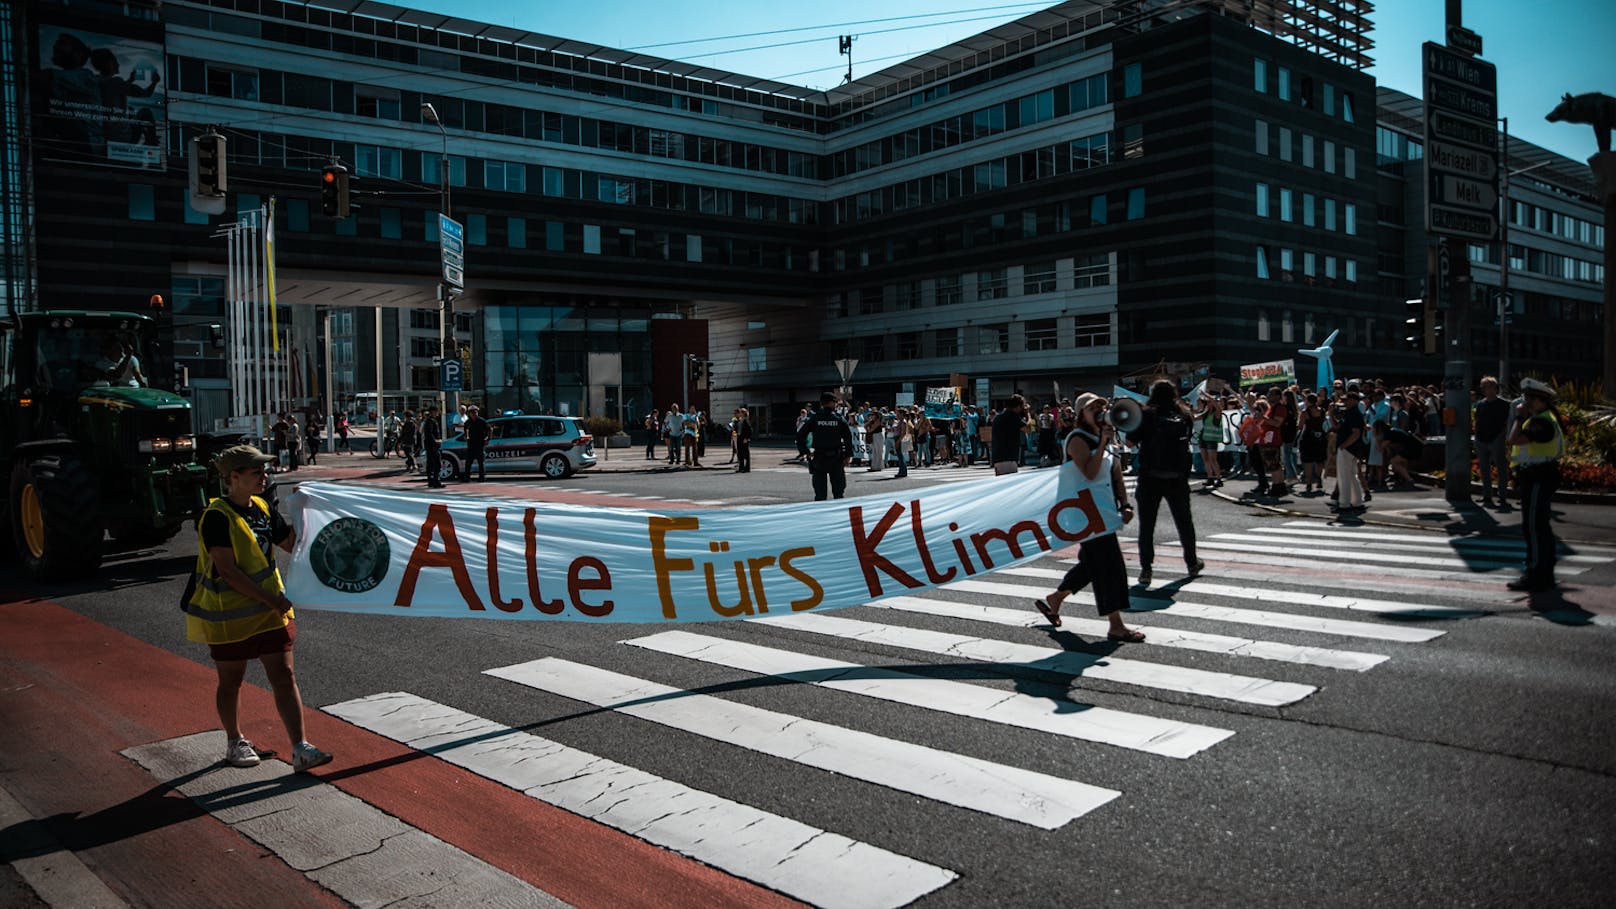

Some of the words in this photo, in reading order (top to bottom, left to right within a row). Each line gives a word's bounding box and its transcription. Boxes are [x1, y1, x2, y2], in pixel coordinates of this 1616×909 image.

[1456, 59, 1480, 85] Wien
[1461, 90, 1490, 115] Krems
[1432, 143, 1477, 173] Mariazell
[1456, 181, 1481, 204] Melk
[446, 365, 459, 382] P
[817, 420, 838, 428] POLIZEI
[318, 519, 365, 545] FRIDAYS
[365, 524, 387, 546] FOR
[394, 503, 614, 617] Alle
[648, 516, 824, 619] Fürs
[849, 488, 1106, 598] Klima
[328, 576, 377, 592] FUTURE
